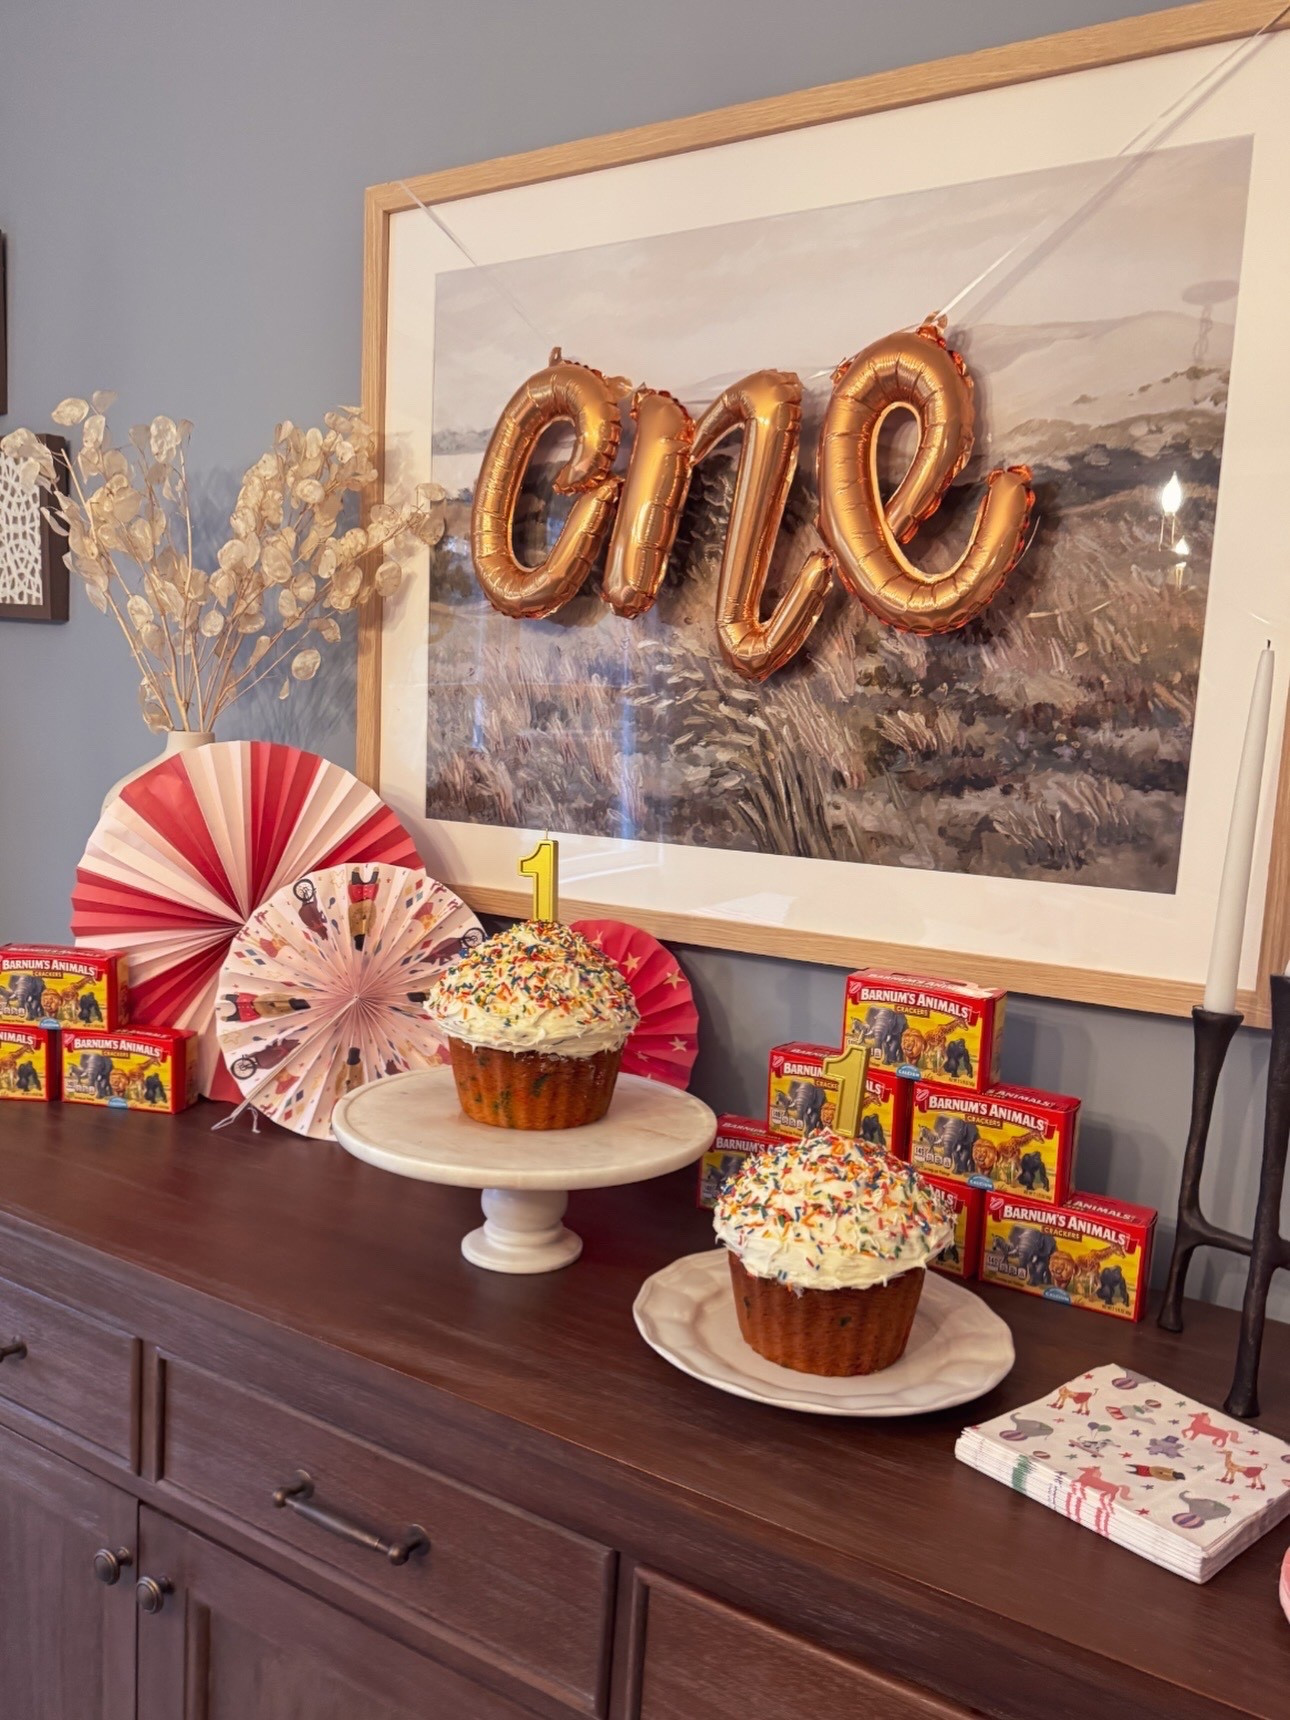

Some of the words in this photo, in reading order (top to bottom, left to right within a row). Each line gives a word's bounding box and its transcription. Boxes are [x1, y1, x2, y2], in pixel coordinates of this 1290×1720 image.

[518, 839, 558, 921] 1
[2, 959, 51, 970] BARNUM'S
[51, 959, 96, 976] ANIMALS
[861, 988, 916, 1005] BARNUM'S
[917, 993, 968, 1018] ANIMALS
[896, 1005, 928, 1016] CRACKERS
[74, 1038, 118, 1050] BARNUM'S
[120, 1040, 160, 1057] ANIMALS
[929, 1095, 987, 1114] BARNUM'S
[989, 1103, 1044, 1130] ANIMALS
[967, 1115, 1000, 1127] CRACKERS
[716, 1136, 765, 1153] BARNUM'S
[1003, 1205, 1066, 1227] BARNUM'S
[1067, 1215, 1126, 1246] ANIMALS
[1044, 1227, 1080, 1240] CRACKERS
